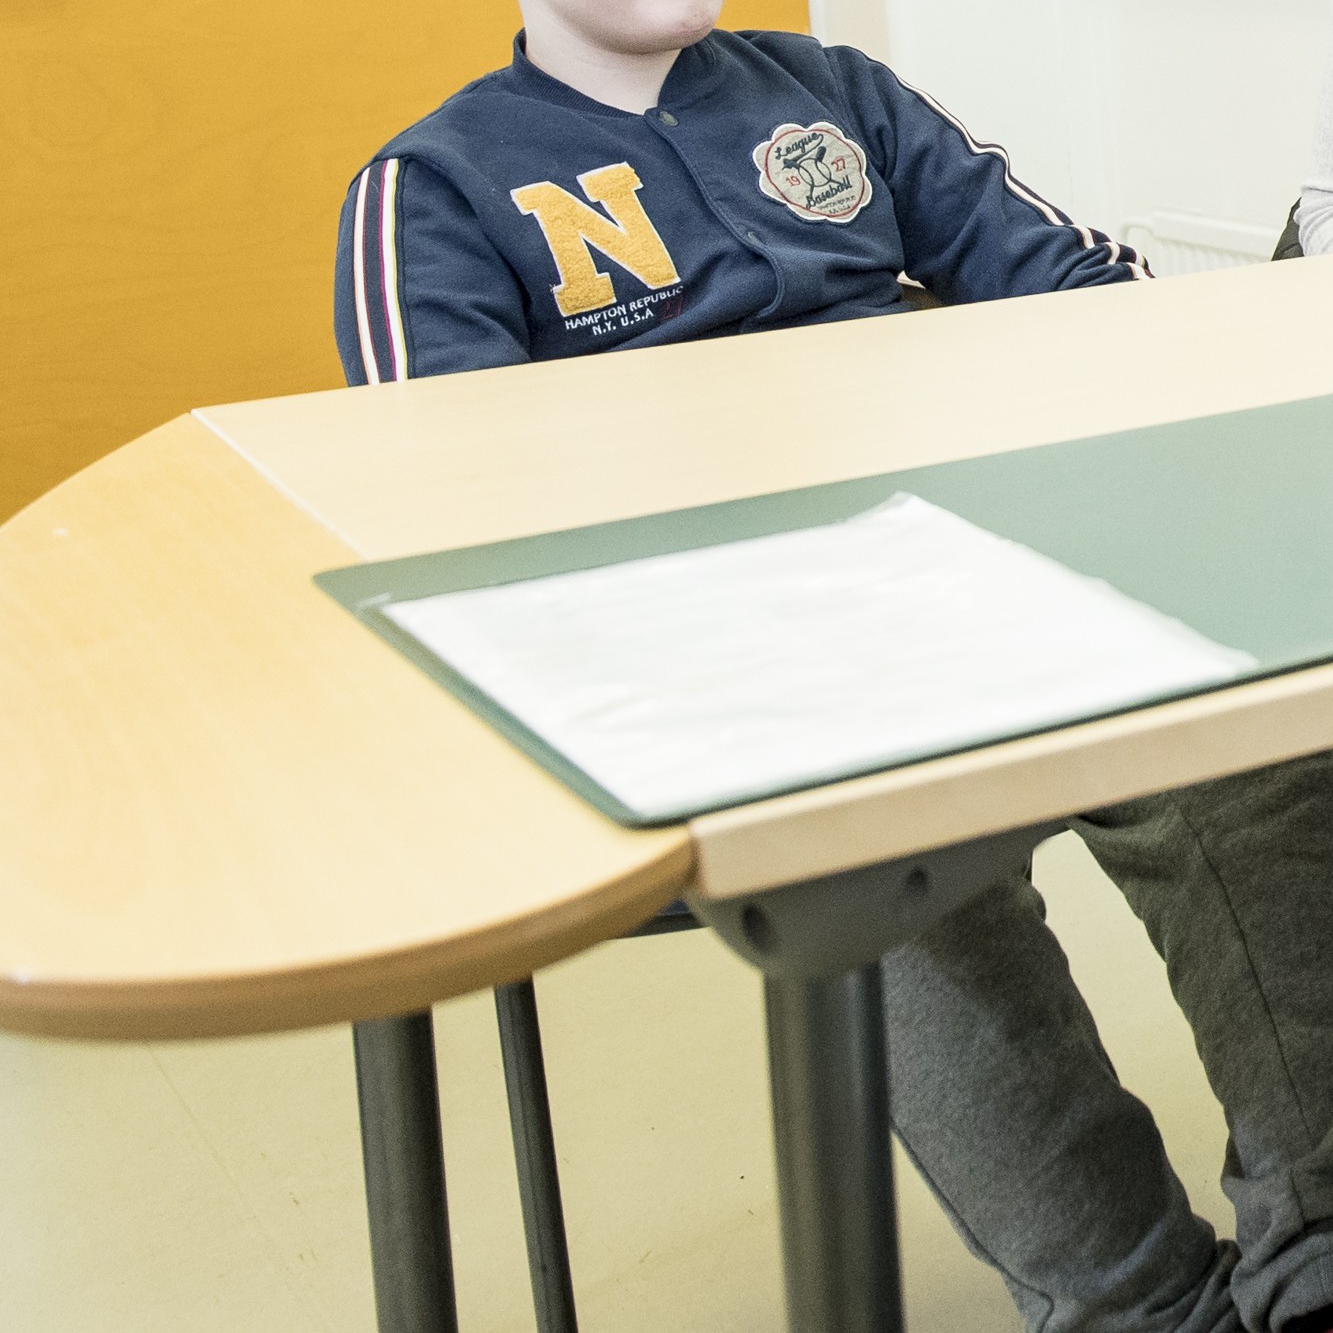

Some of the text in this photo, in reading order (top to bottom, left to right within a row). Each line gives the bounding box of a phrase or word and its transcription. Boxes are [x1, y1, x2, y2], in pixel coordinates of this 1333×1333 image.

[775, 132, 823, 160] League
[786, 157, 846, 187] 19 27
[806, 174, 853, 211] Baseball
[510, 161, 682, 317] N
[565, 285, 684, 330] HAMPTON REPUBLIC
[592, 308, 655, 336] N.Y. U.S.A
